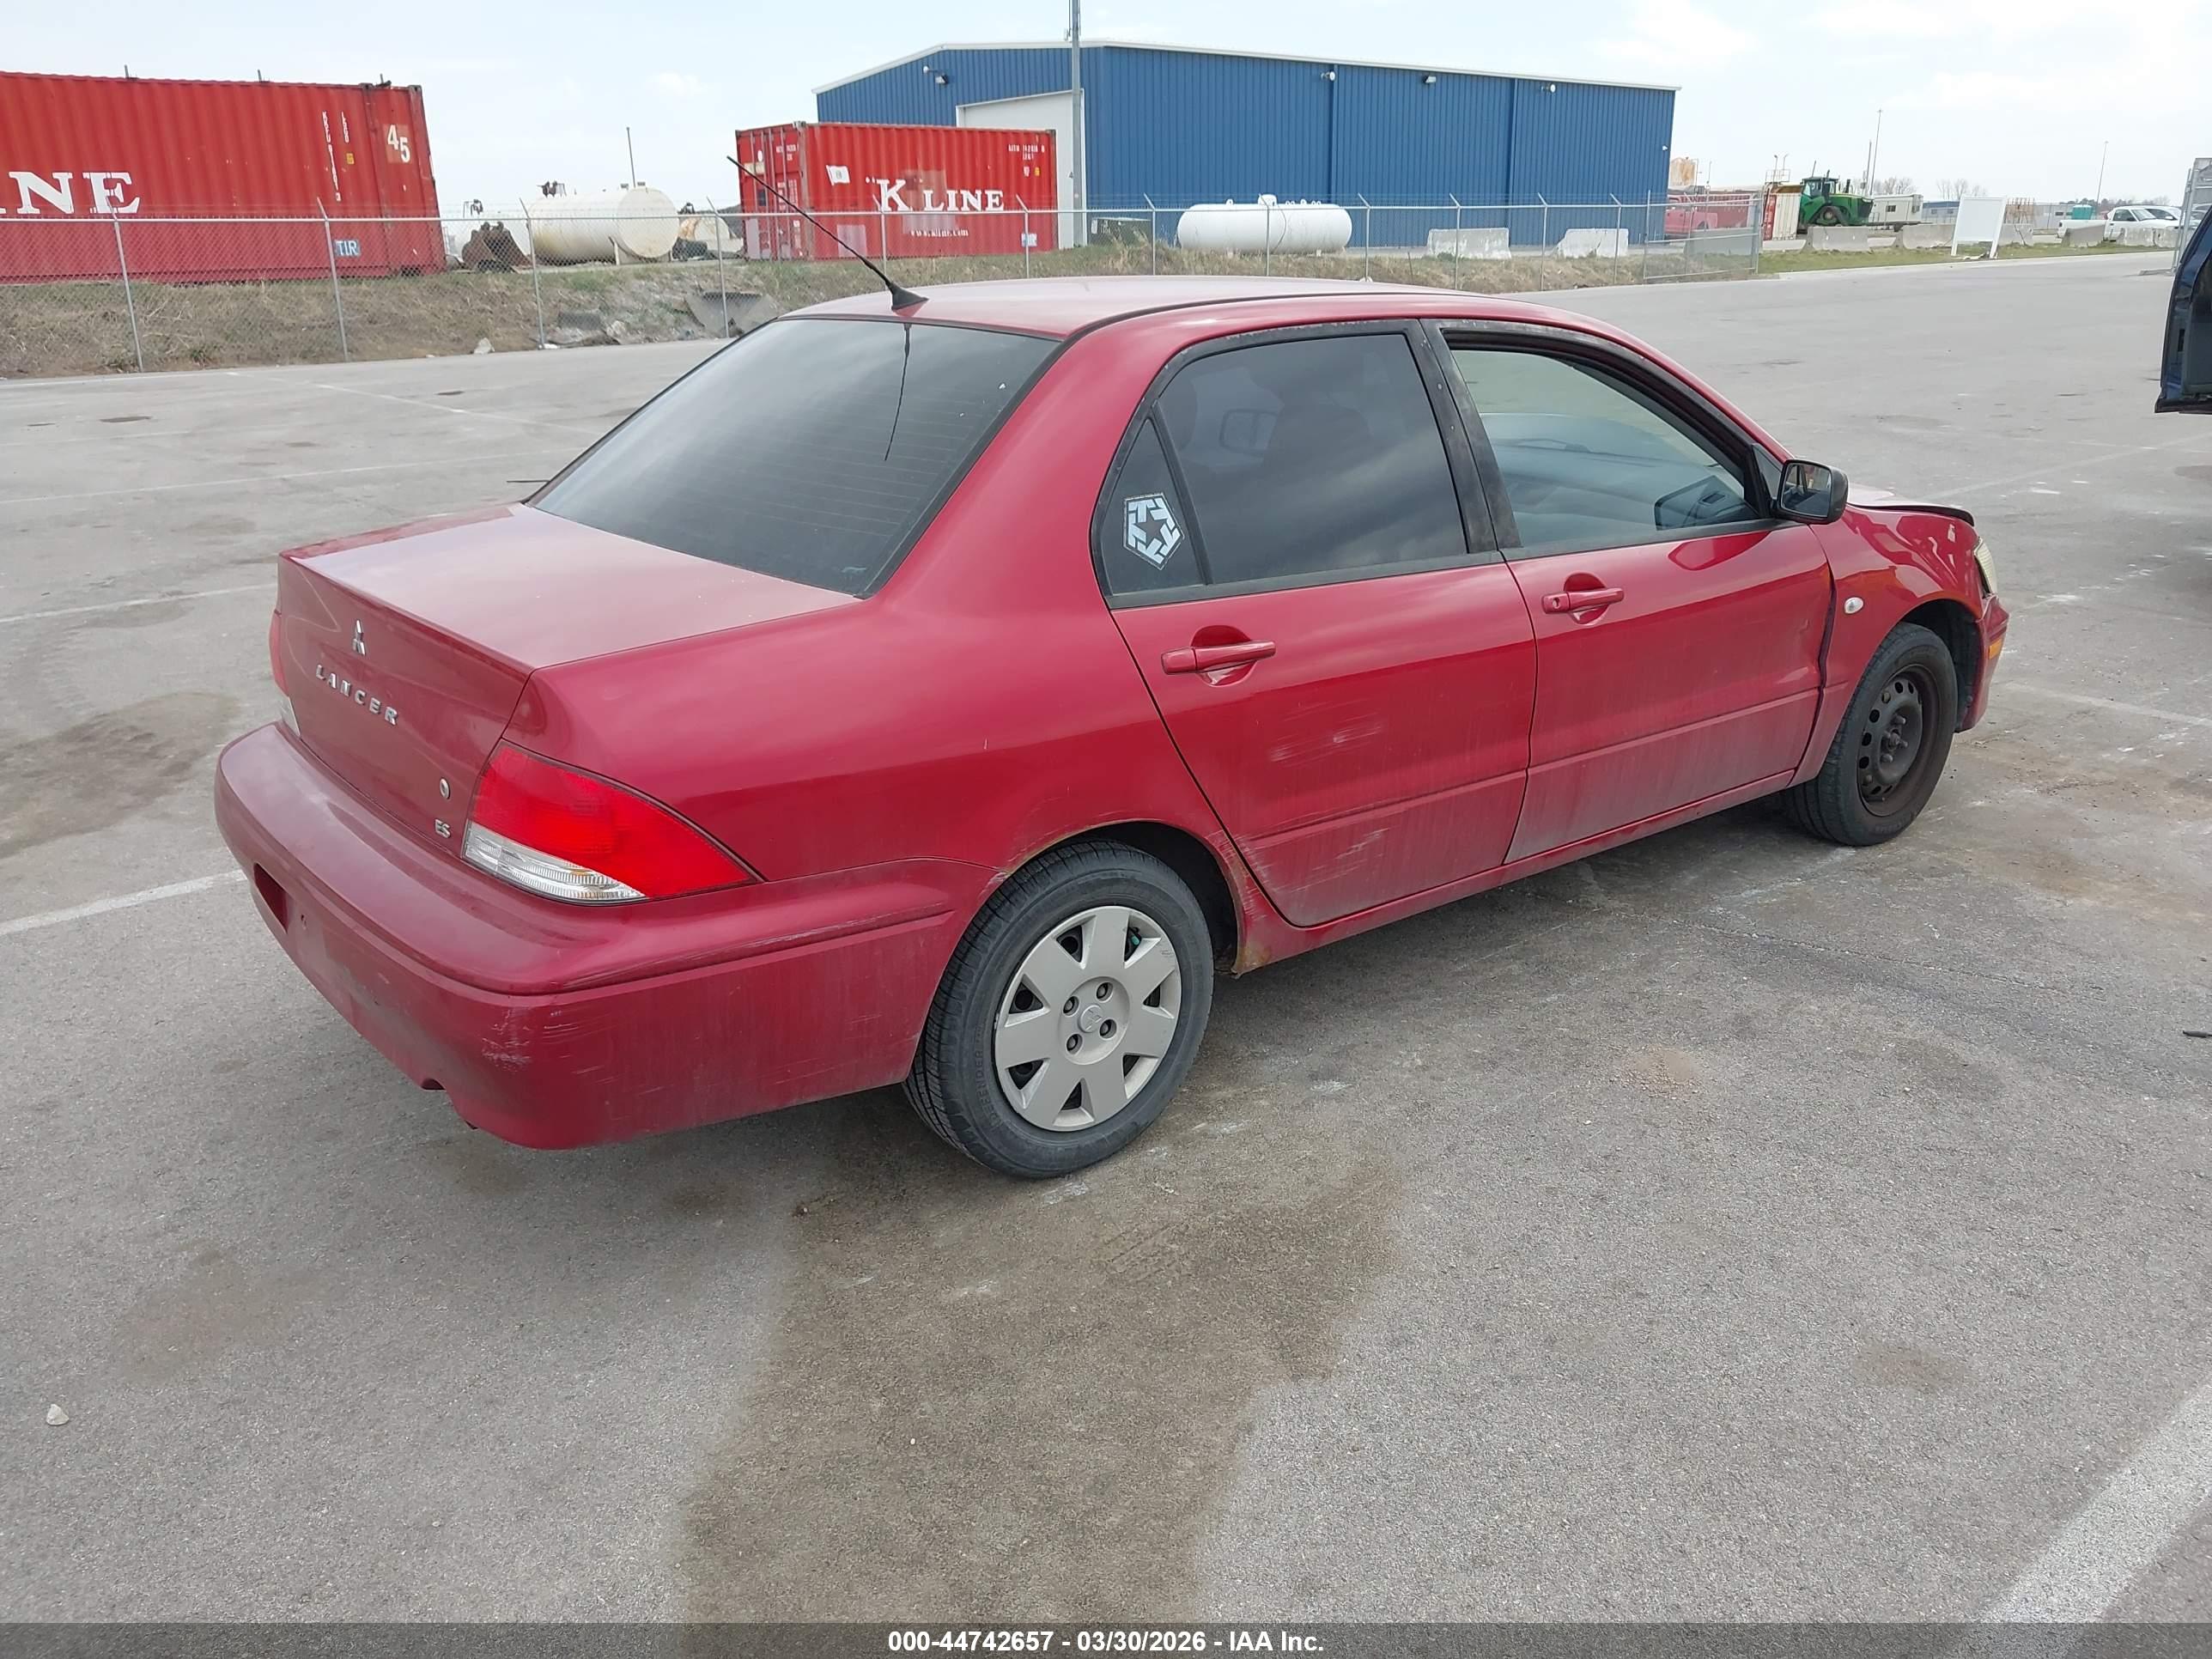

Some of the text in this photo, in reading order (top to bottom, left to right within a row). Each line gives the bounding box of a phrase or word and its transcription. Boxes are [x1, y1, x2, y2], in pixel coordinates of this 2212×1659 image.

[387, 124, 410, 163] 45
[0, 171, 143, 214] NE
[923, 190, 1005, 211] LINE
[336, 240, 358, 257] TIR
[315, 664, 398, 726] LANCER
[434, 818, 451, 839] ES
